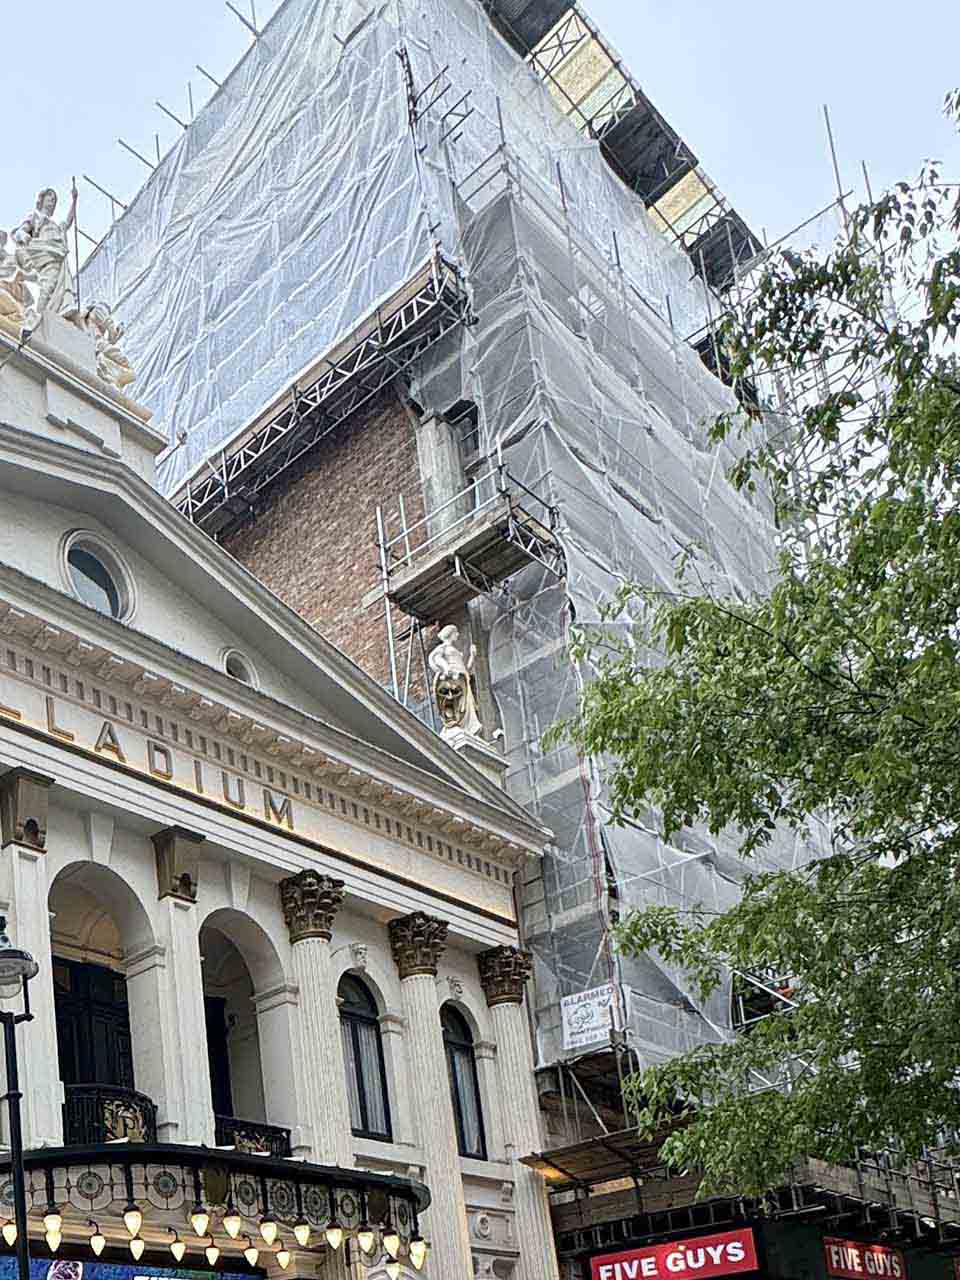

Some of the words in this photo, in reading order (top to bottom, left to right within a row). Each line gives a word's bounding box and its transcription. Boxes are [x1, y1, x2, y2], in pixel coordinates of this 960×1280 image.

[666, 1241, 746, 1273] GUYS
[830, 1245, 863, 1272] FIVE
[864, 1250, 901, 1278] GUYS
